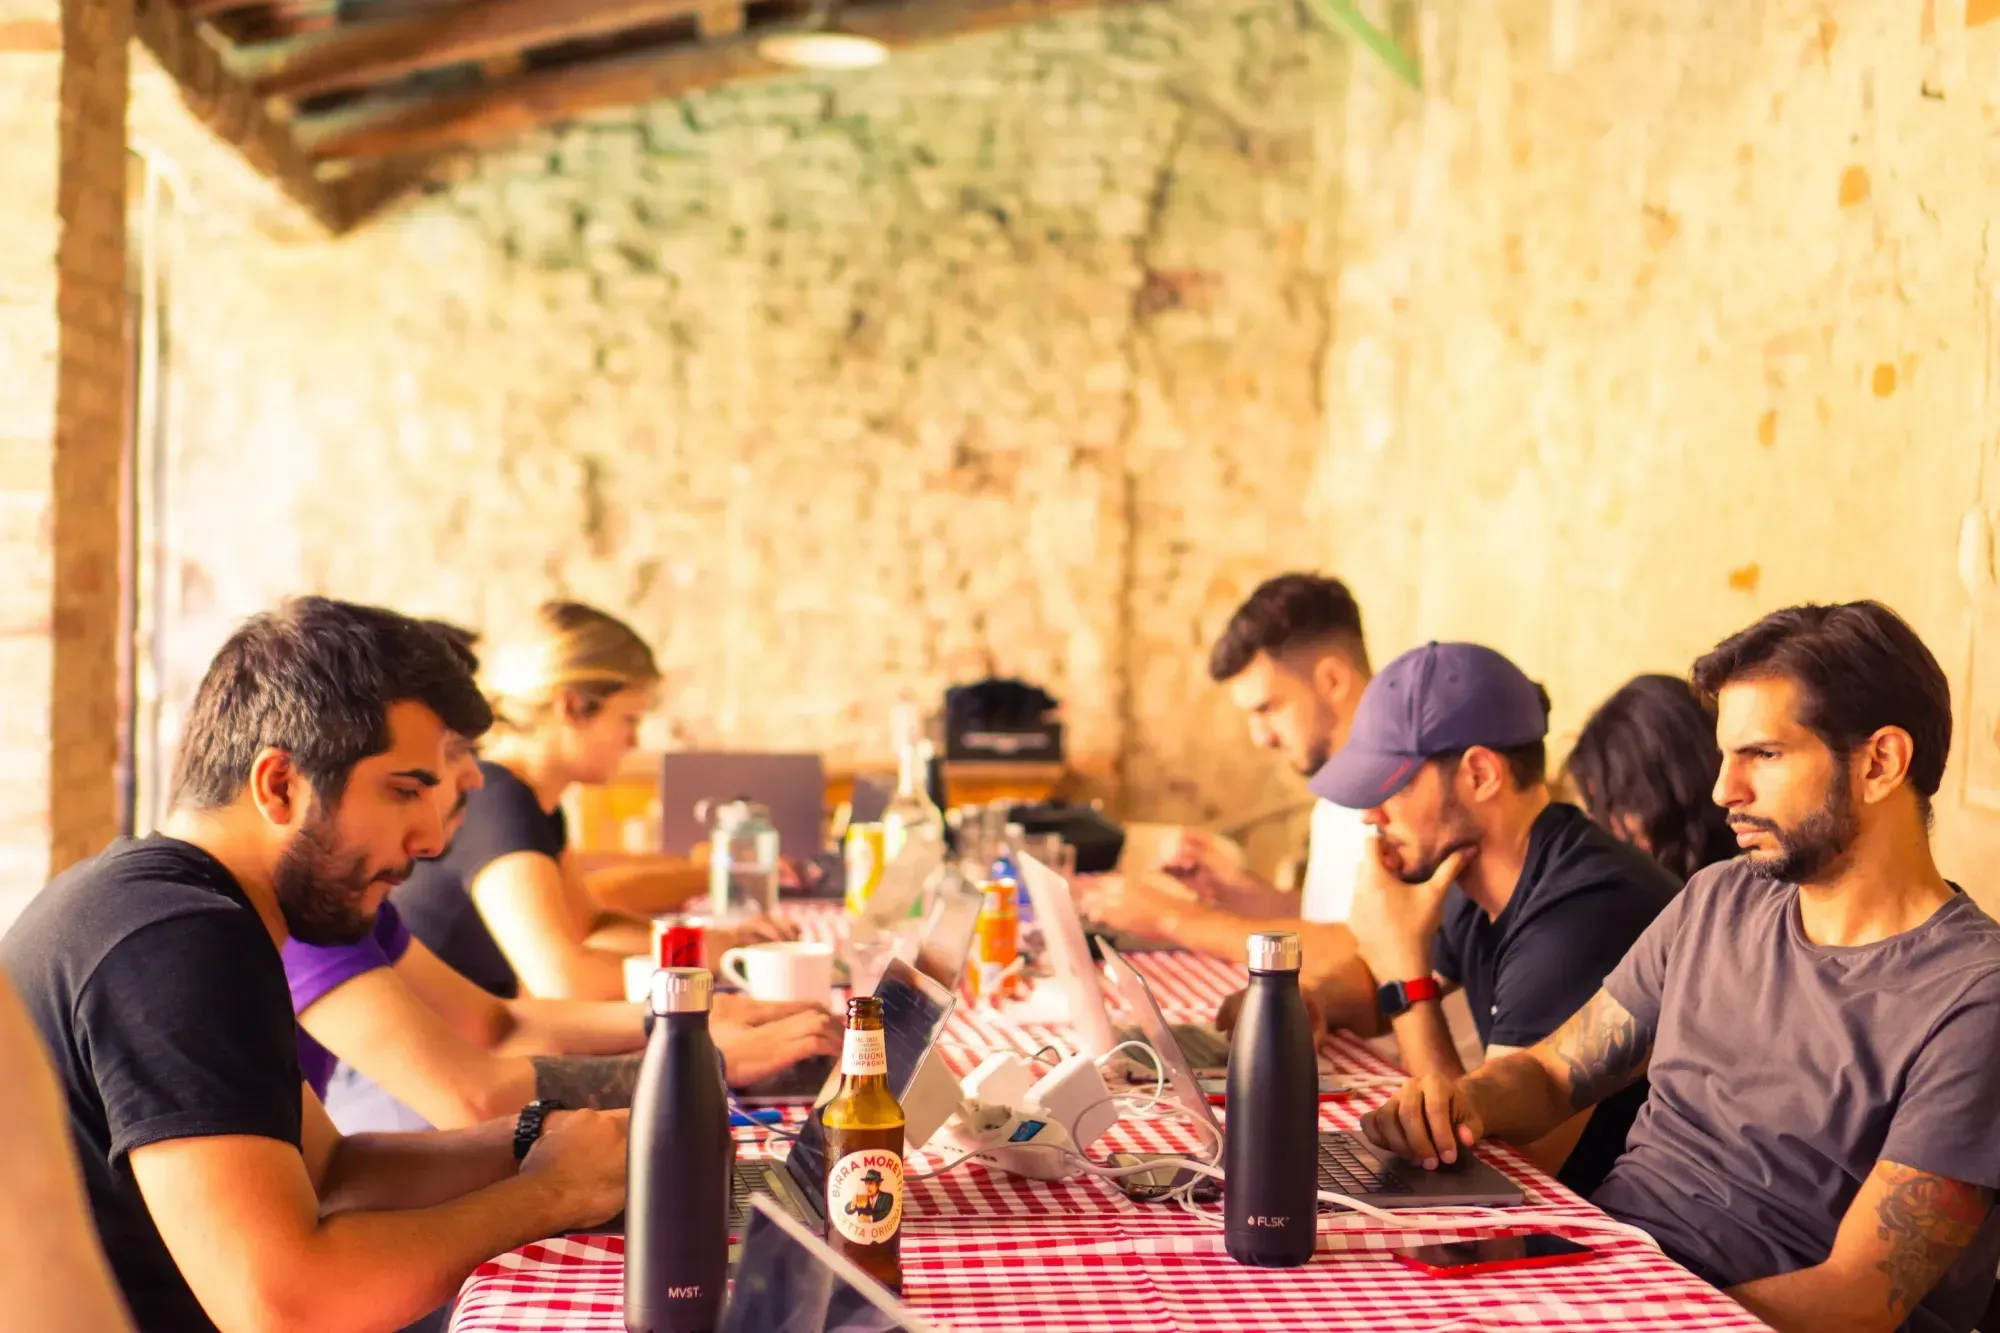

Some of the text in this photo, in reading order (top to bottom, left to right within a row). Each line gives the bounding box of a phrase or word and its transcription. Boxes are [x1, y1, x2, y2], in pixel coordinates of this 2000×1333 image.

[851, 1059, 885, 1067] OMPAGNIA
[832, 1160, 860, 1198] BIRRA
[668, 1286, 702, 1298] MVST.
